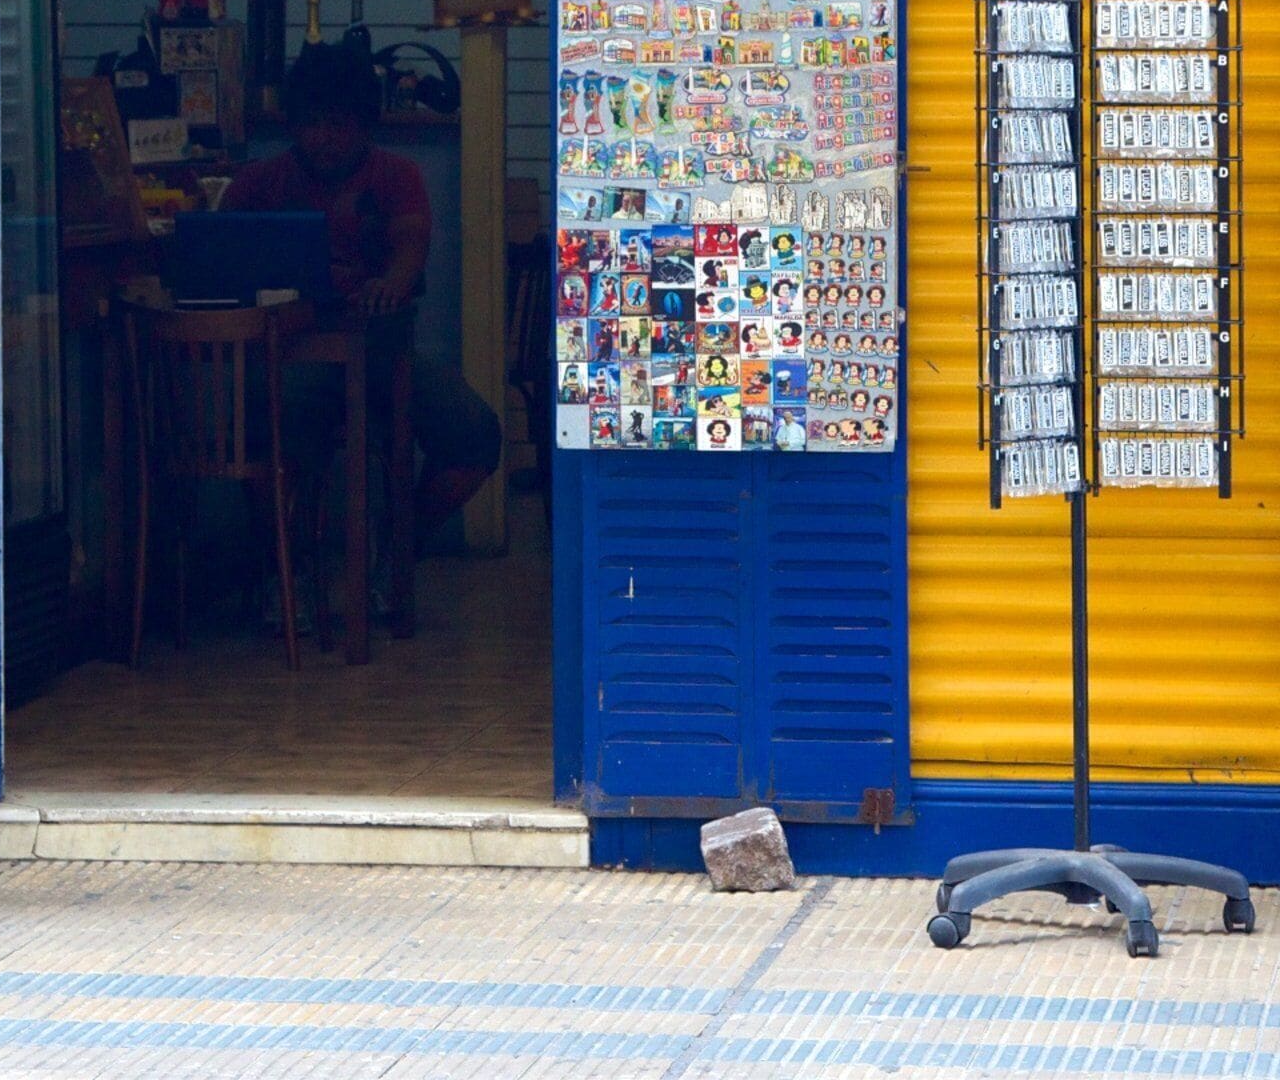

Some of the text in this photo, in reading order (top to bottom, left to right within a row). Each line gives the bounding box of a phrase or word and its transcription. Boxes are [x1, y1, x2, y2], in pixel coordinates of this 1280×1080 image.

[1218, 0, 1228, 12] A
[1218, 56, 1228, 67] B
[1141, 62, 1151, 87] LAURA
[1218, 113, 1228, 124] C
[1218, 167, 1228, 178] D
[1220, 222, 1229, 233] E
[1220, 277, 1229, 289] F
[1220, 332, 1230, 343] G
[1220, 386, 1229, 398] H
